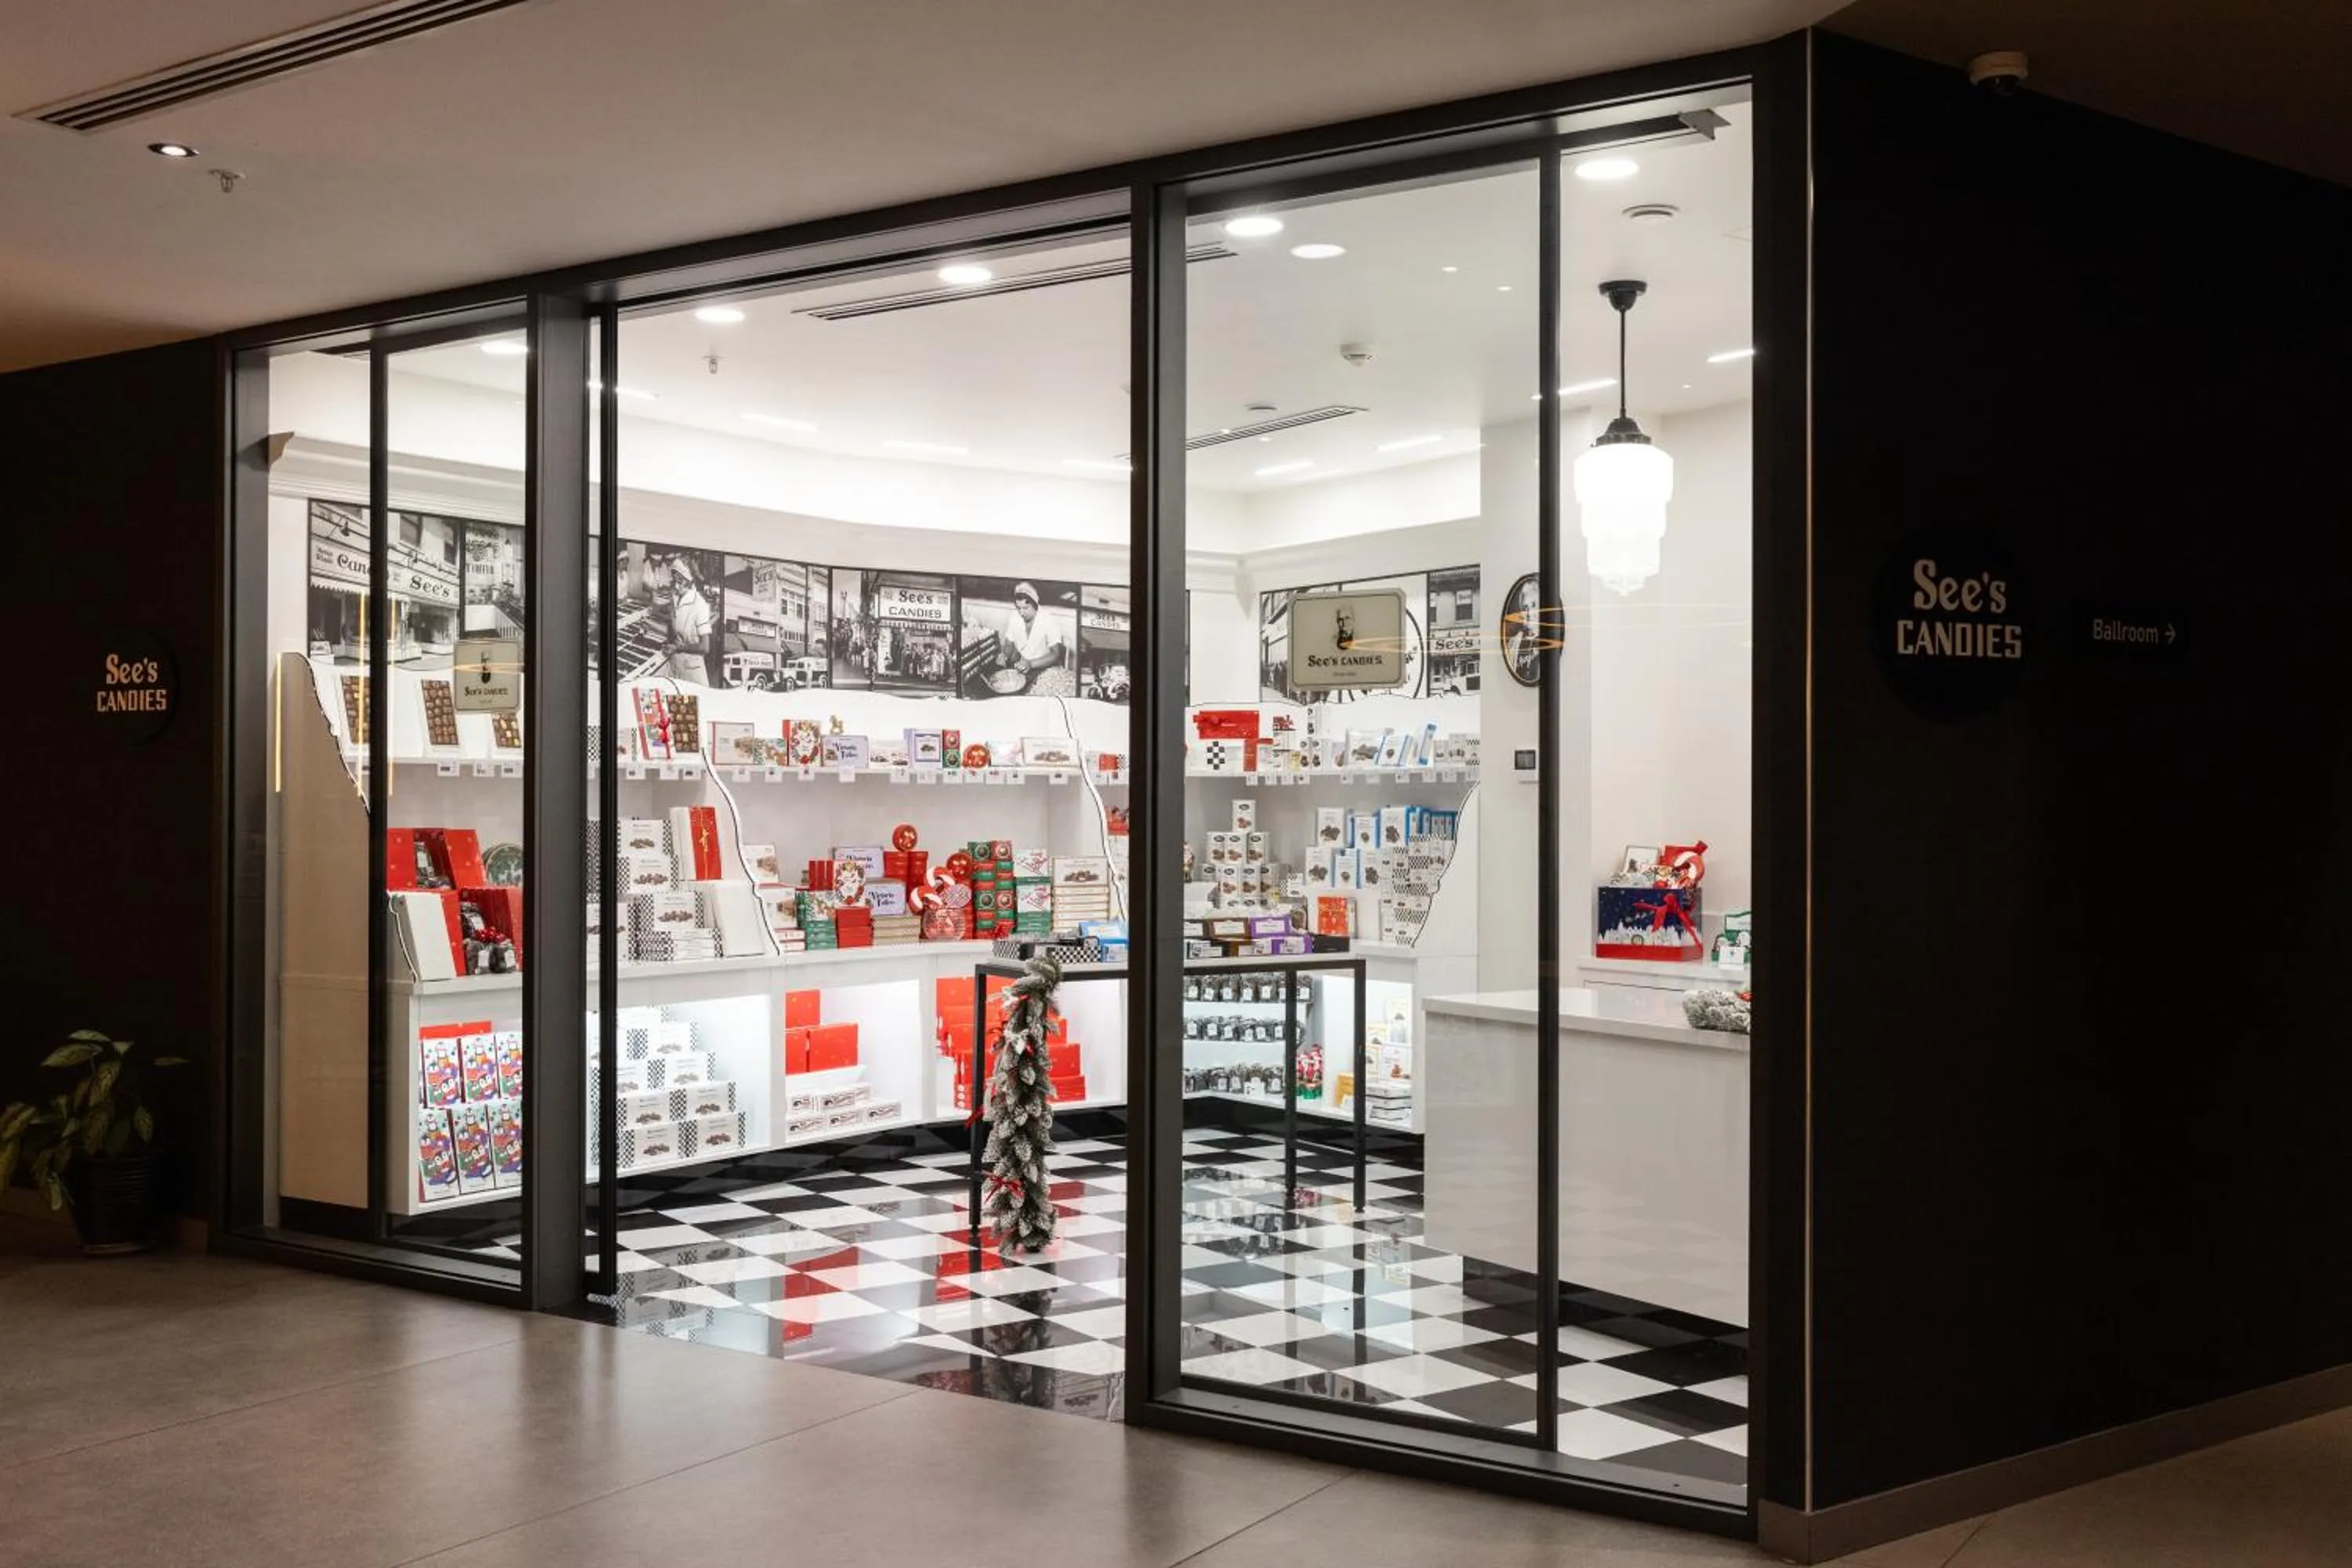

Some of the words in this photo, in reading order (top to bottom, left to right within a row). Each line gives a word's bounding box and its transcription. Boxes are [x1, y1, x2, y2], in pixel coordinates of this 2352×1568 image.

[337, 554, 370, 576] Can
[410, 574, 450, 598] See's
[898, 589, 933, 604] See's
[1913, 557, 2007, 615] See's
[888, 606, 942, 619] CANDIES
[1896, 619, 2023, 659] CANDIES
[2092, 617, 2159, 644] Ballroom
[1436, 637, 1473, 650] See's
[106, 653, 158, 684] See's
[1308, 655, 1338, 667] See's
[1341, 655, 1383, 666] CANDIES
[96, 689, 167, 712] CANDIES
